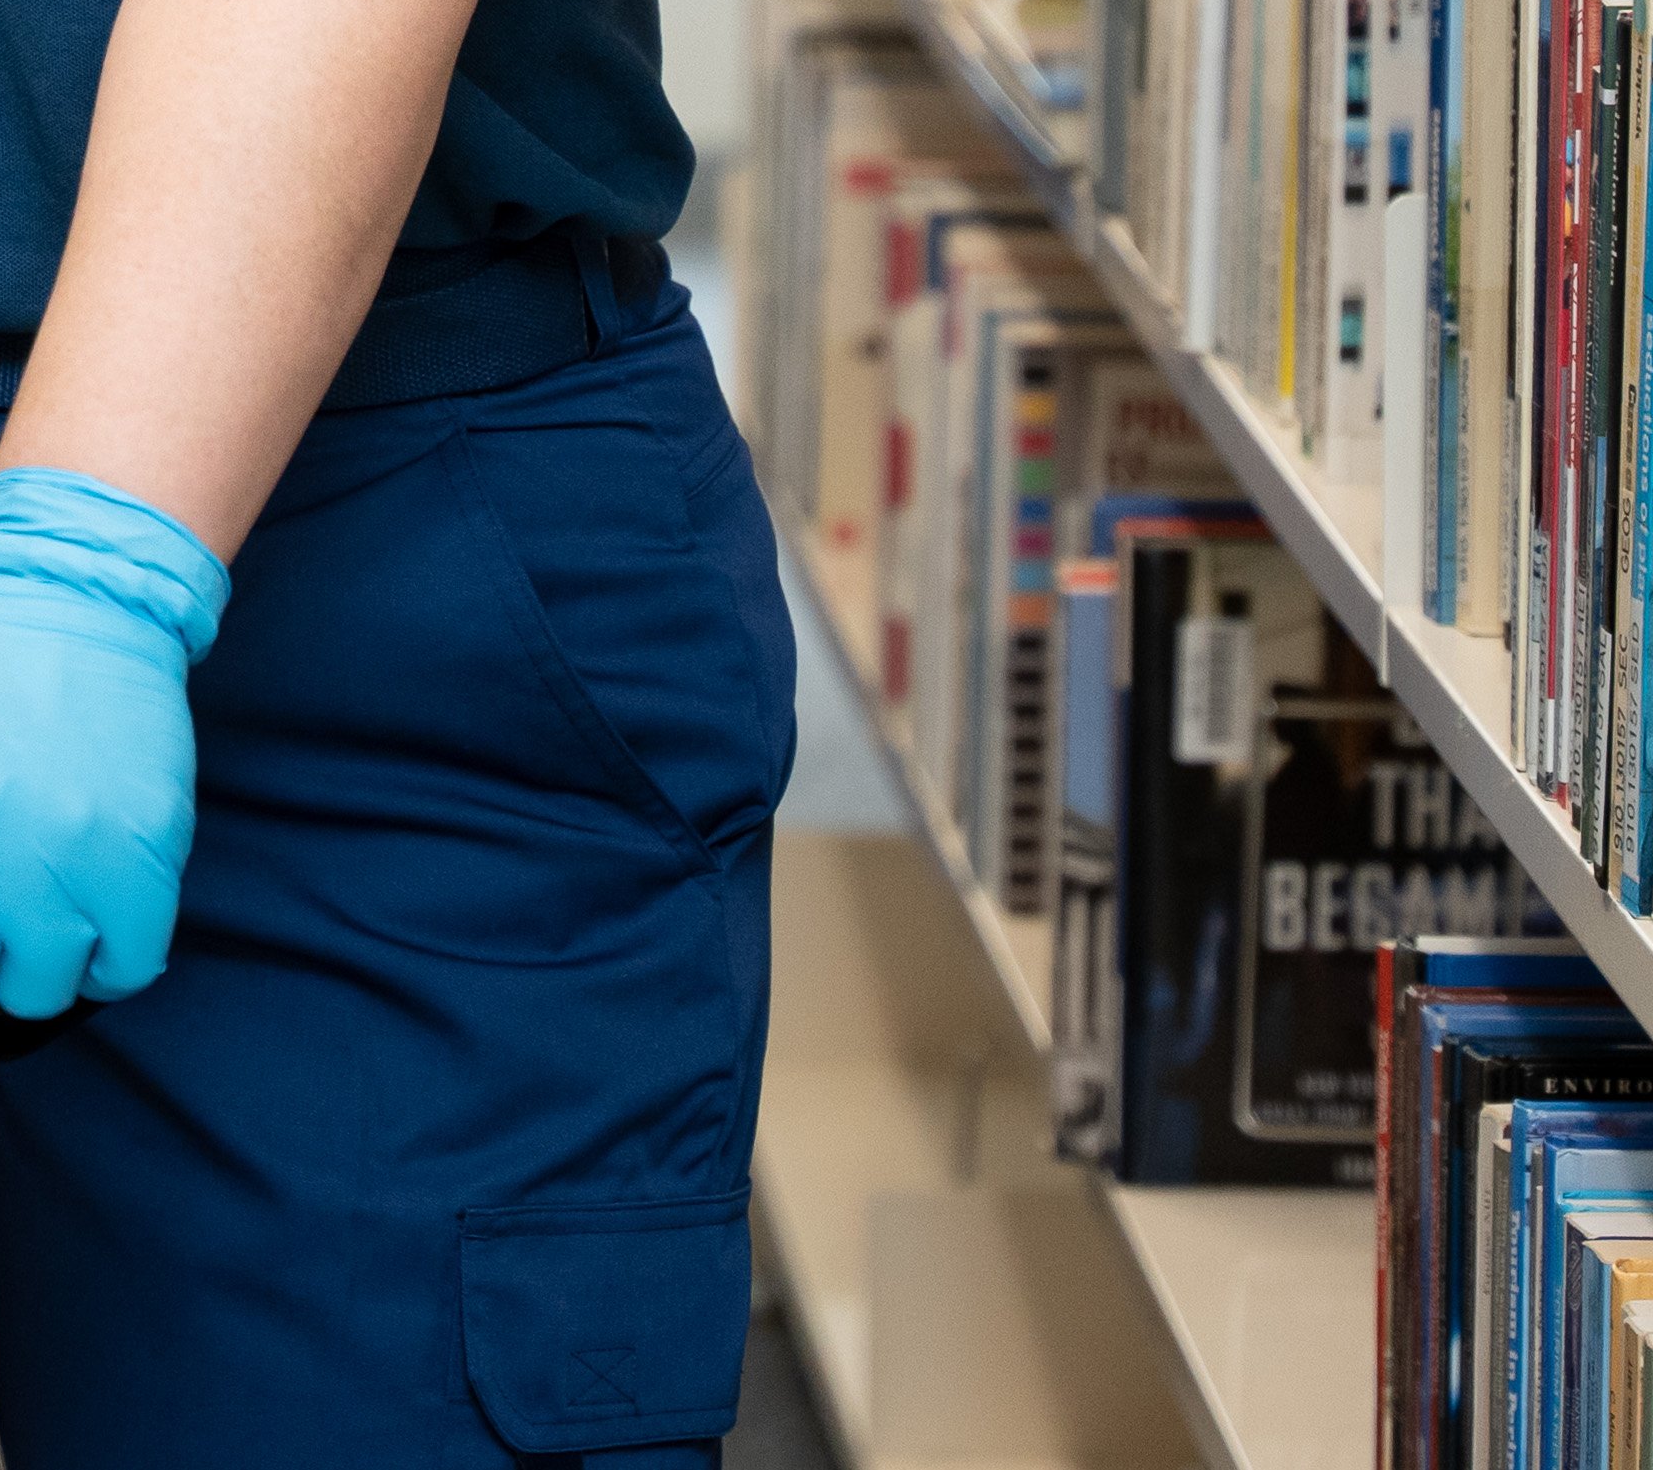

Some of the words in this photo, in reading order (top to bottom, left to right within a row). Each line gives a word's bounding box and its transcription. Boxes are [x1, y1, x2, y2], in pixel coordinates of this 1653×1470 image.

[1620, 496, 1631, 573] GEOG
[1638, 502, 1649, 531] of
[1616, 632, 1628, 689] SEC
[1629, 621, 1640, 685] SED
[1570, 645, 1584, 799] 910.130157
[1612, 705, 1627, 850] 910.130157
[1625, 691, 1639, 853] 910.130157
